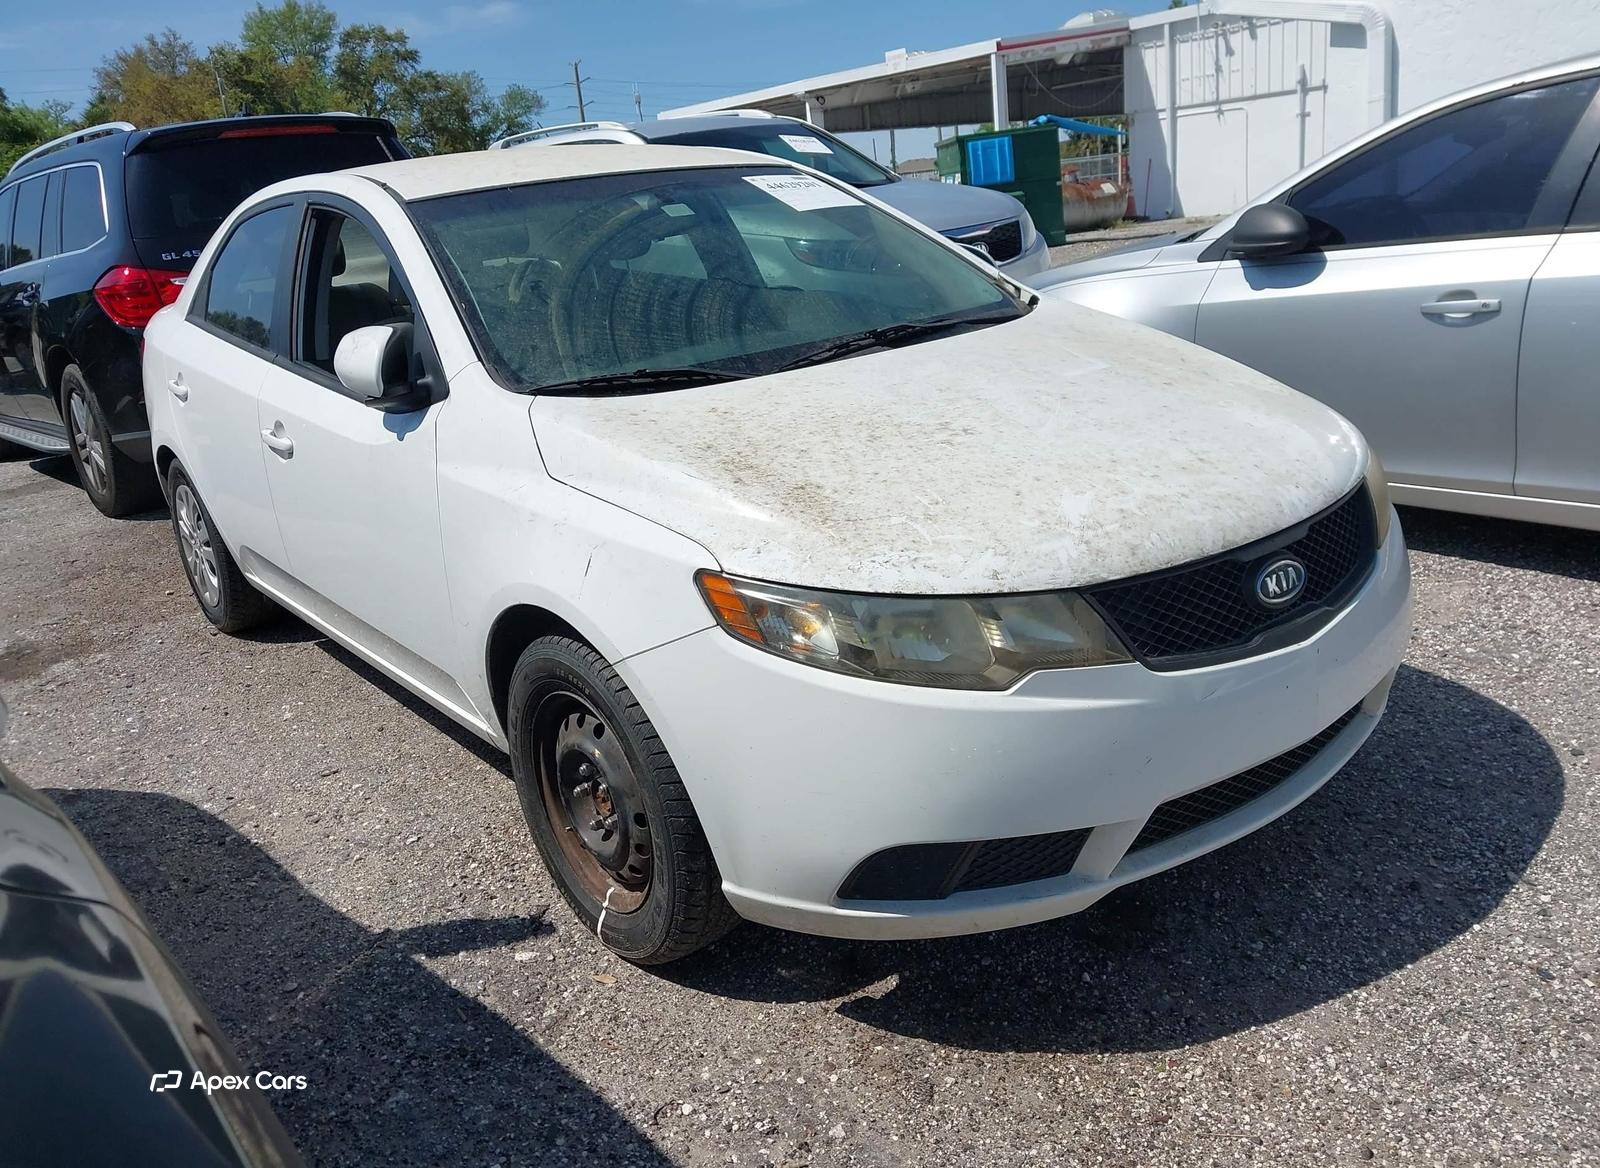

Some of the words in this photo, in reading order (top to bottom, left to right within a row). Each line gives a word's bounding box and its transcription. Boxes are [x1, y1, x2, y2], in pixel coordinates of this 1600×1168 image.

[161, 252, 180, 260] GL
[182, 250, 201, 258] 45
[1264, 566, 1299, 598] KIA
